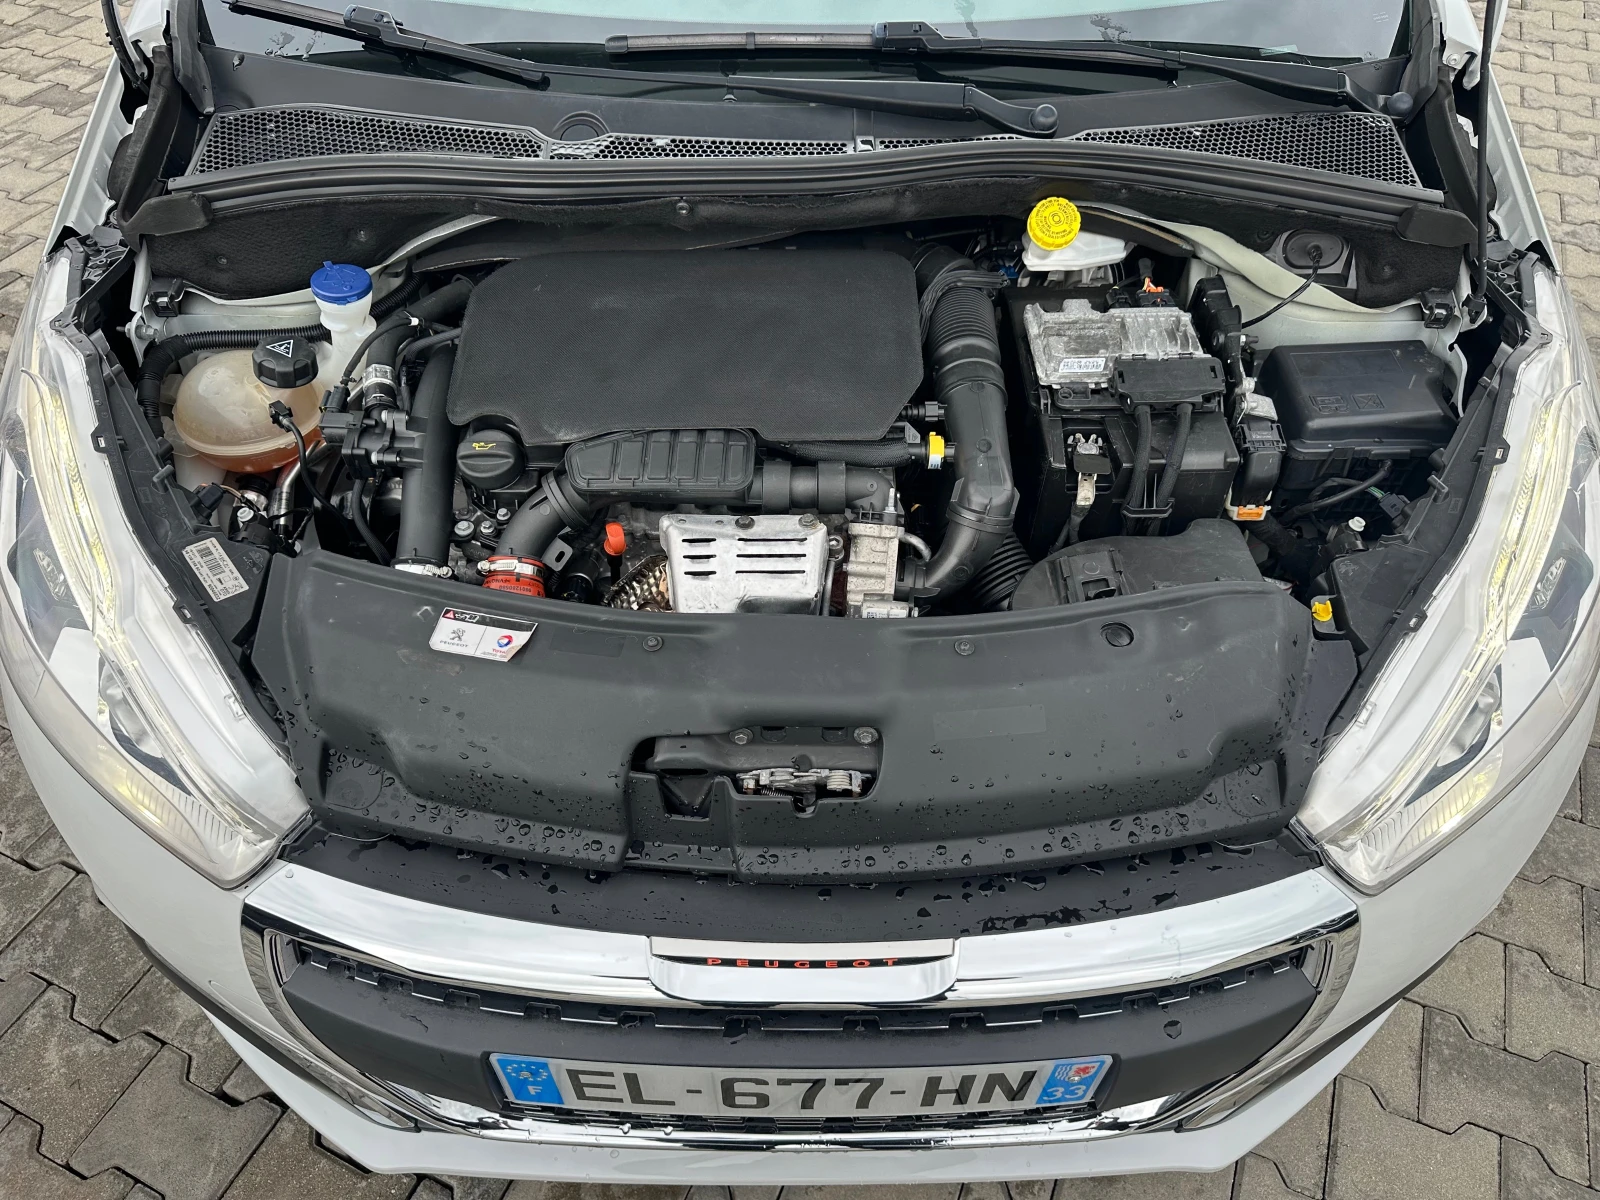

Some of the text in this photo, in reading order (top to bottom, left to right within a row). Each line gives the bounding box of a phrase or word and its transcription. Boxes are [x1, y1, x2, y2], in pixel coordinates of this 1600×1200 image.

[439, 640, 469, 648] PEUGEOT
[707, 957, 898, 968] PEUGEOT
[527, 1085, 543, 1095] F
[566, 1069, 1038, 1109] EL-677-HN
[1043, 1085, 1086, 1101] 33
